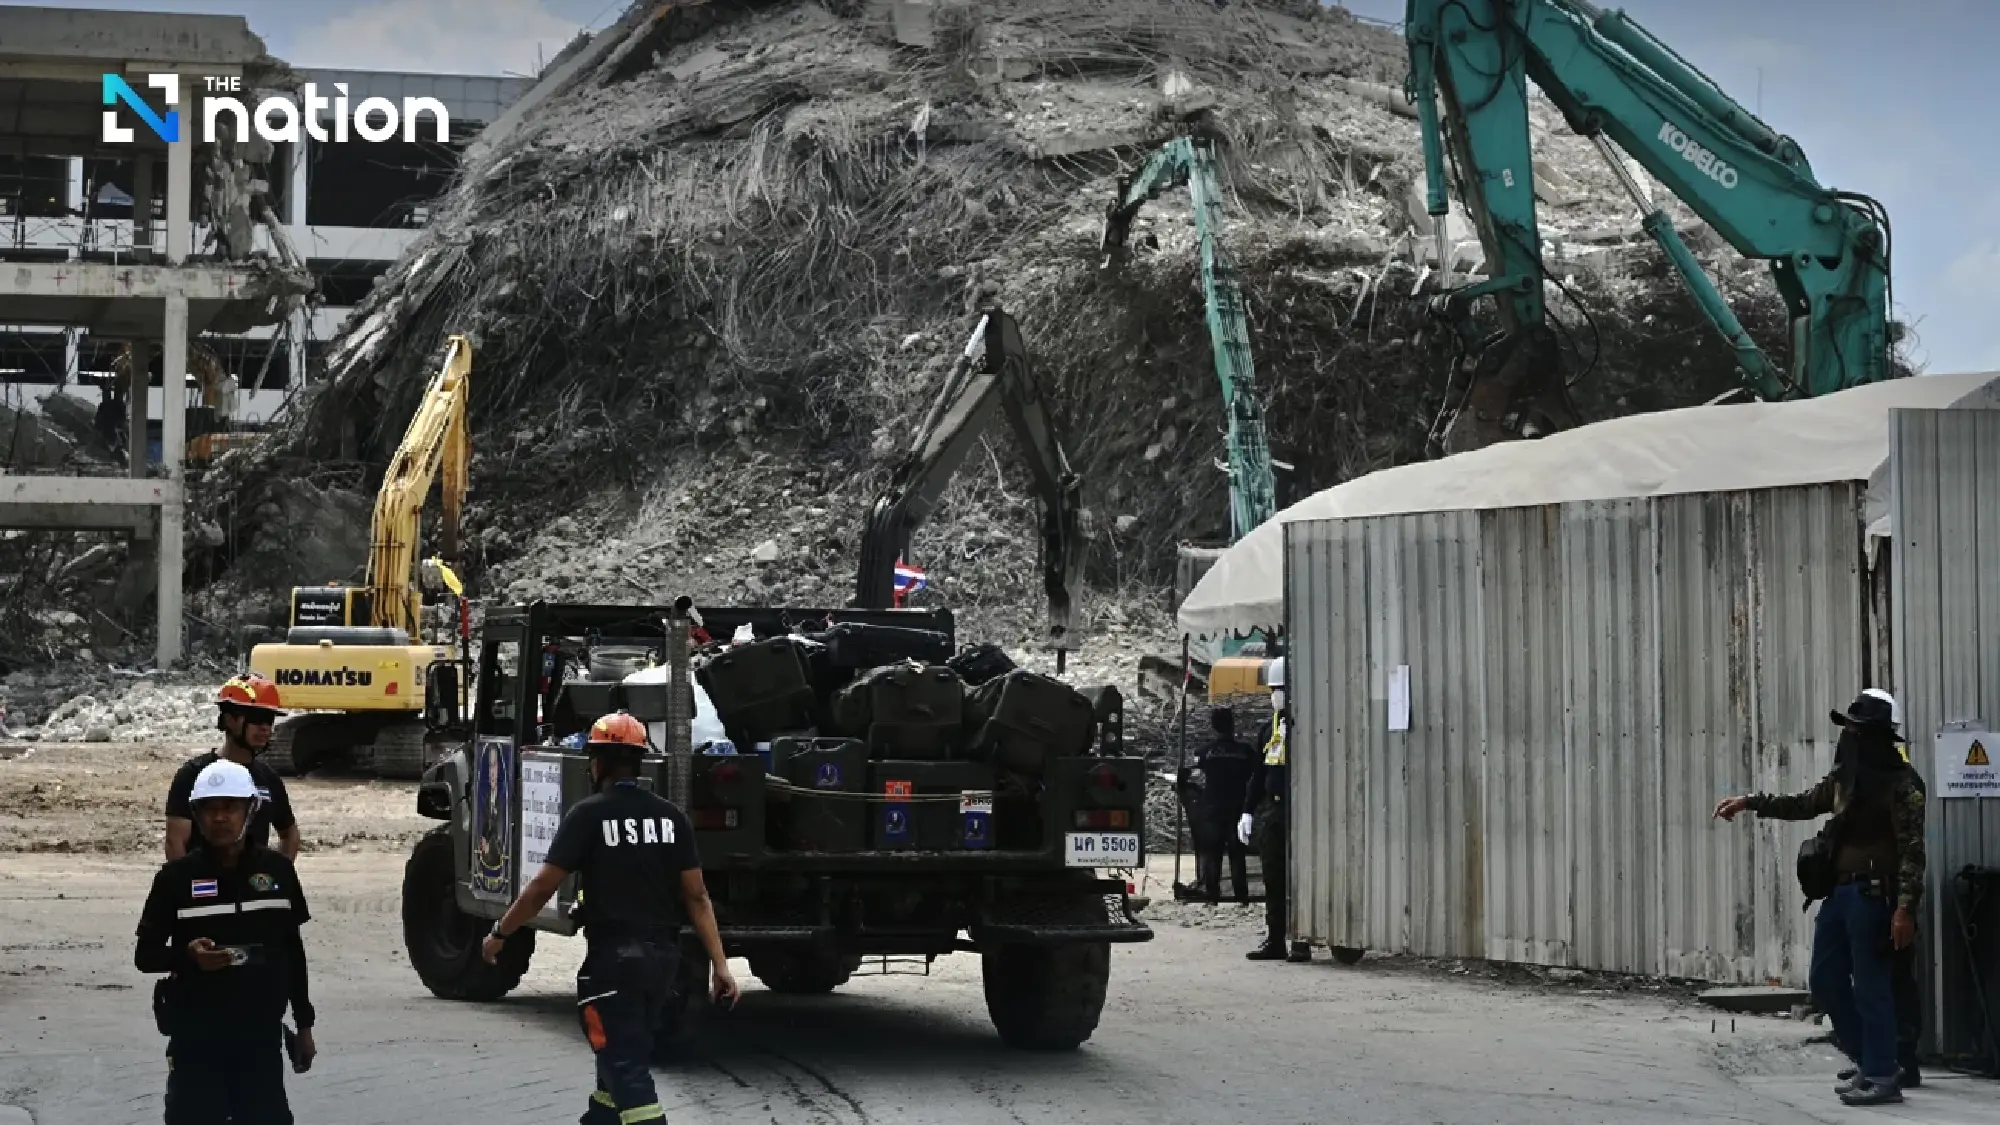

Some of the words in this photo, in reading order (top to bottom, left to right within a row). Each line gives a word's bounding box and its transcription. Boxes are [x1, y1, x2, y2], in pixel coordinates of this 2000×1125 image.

[1658, 121, 1738, 189] KOBELCO
[275, 666, 372, 686] KOMATSU
[602, 816, 675, 847] USAR
[1102, 836, 1136, 852] 5508
